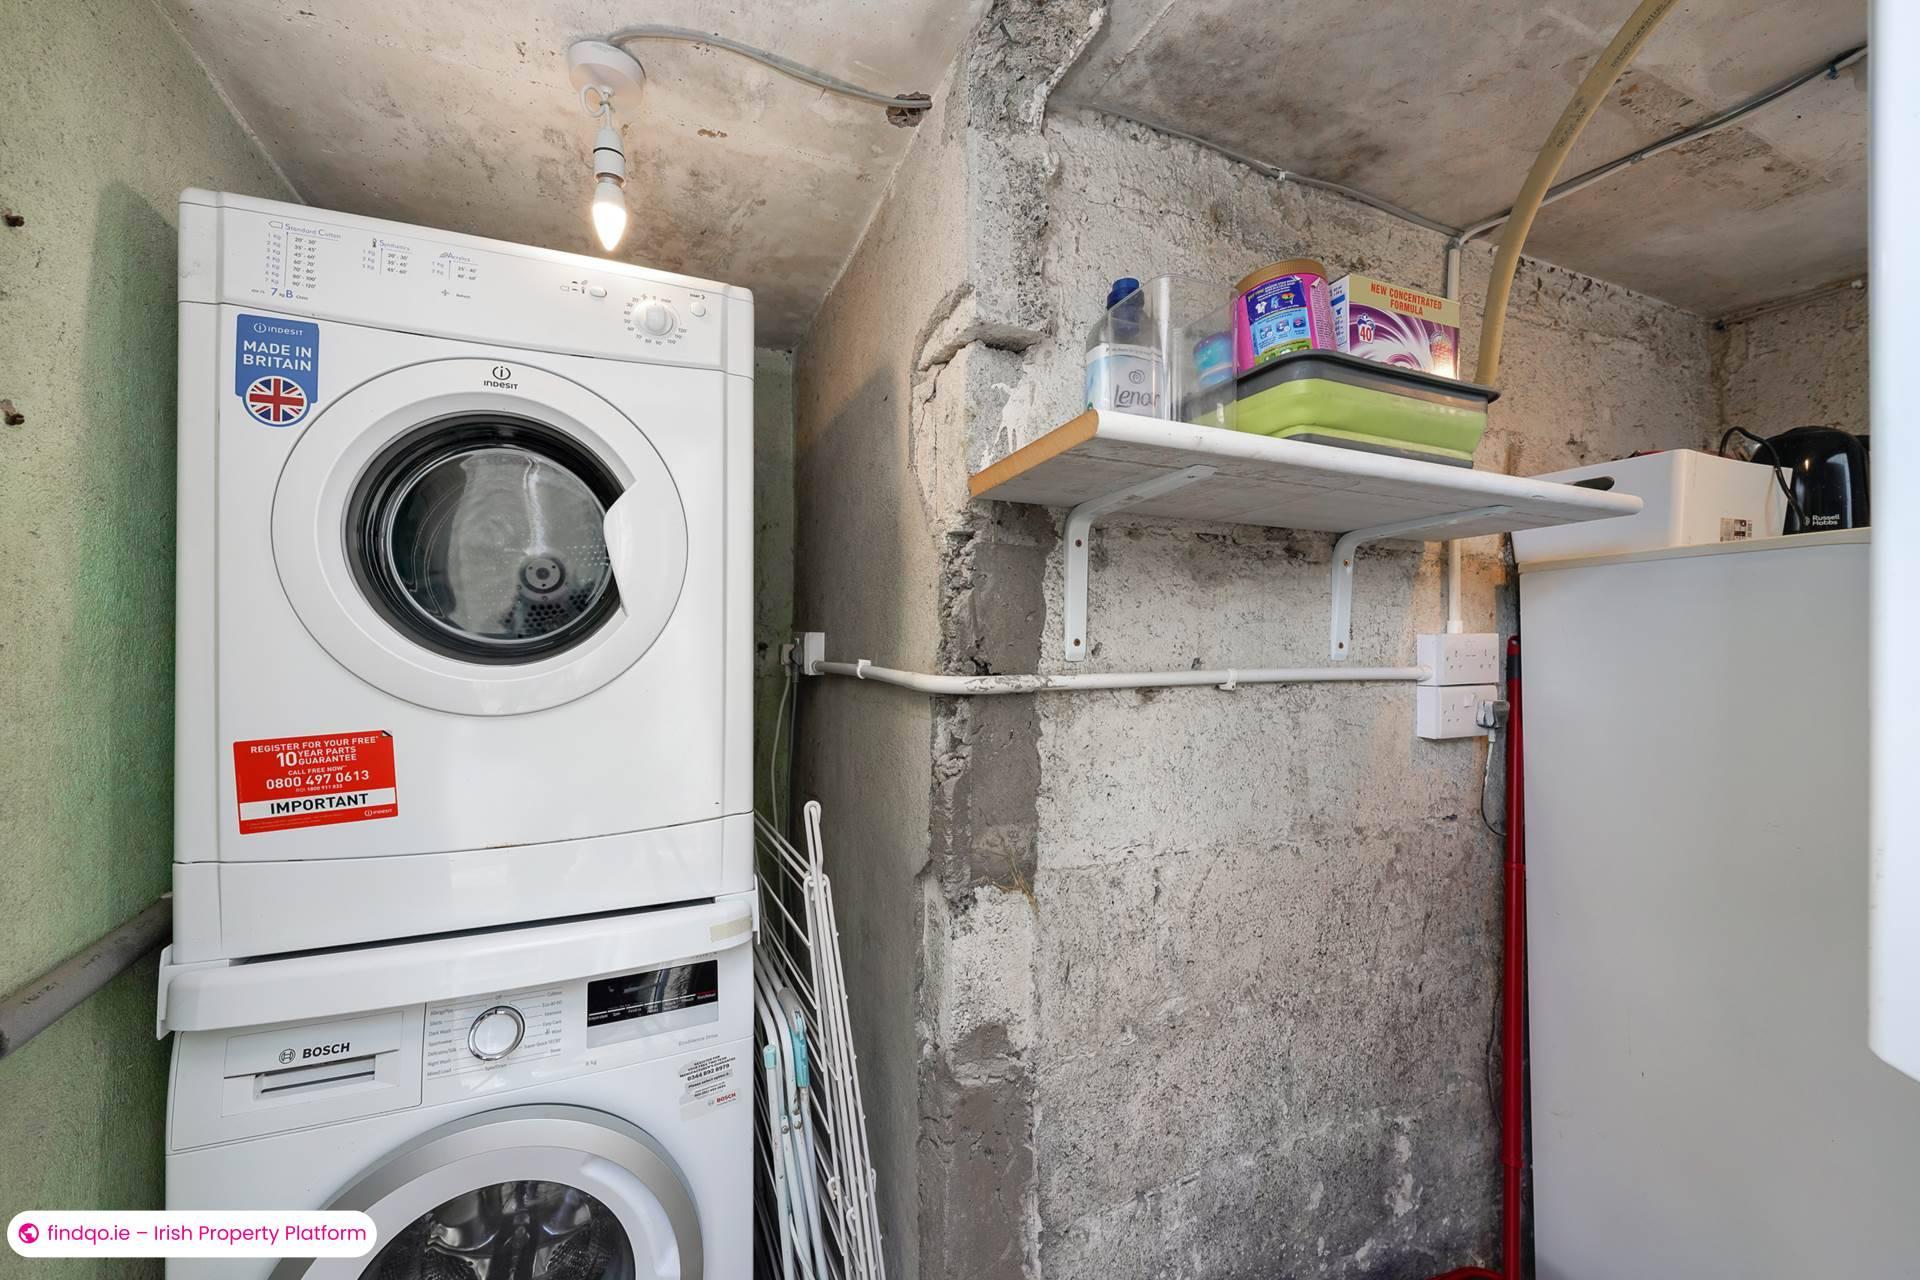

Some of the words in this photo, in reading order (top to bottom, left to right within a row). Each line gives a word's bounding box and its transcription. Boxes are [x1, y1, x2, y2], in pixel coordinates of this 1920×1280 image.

[271, 288, 278, 296] 7
[285, 289, 294, 298] B
[1370, 282, 1387, 295] NEW
[1389, 287, 1443, 310] CONCENTRATED
[1390, 299, 1424, 316] FORMULA
[1360, 327, 1372, 341] 40
[243, 340, 291, 356] MADE
[295, 346, 312, 358] IN
[243, 354, 312, 372] BRITAIN
[250, 743, 300, 754] REGISTER
[302, 741, 321, 749] FOR
[323, 738, 349, 747] YOUR
[298, 749, 323, 757] YEAR
[325, 746, 357, 755] PARTS
[276, 751, 298, 768] 10
[298, 754, 357, 766] GUARANTEE
[266, 776, 301, 790] 0800
[305, 773, 331, 786] 497
[335, 770, 369, 784] 0613
[288, 768, 306, 776] CALL
[270, 793, 369, 815] IMPORTANT
[302, 1042, 350, 1059] BOSCH
[687, 1073, 702, 1081] 0344
[703, 1068, 715, 1076] 892
[717, 1092, 736, 1103] BOSCH
